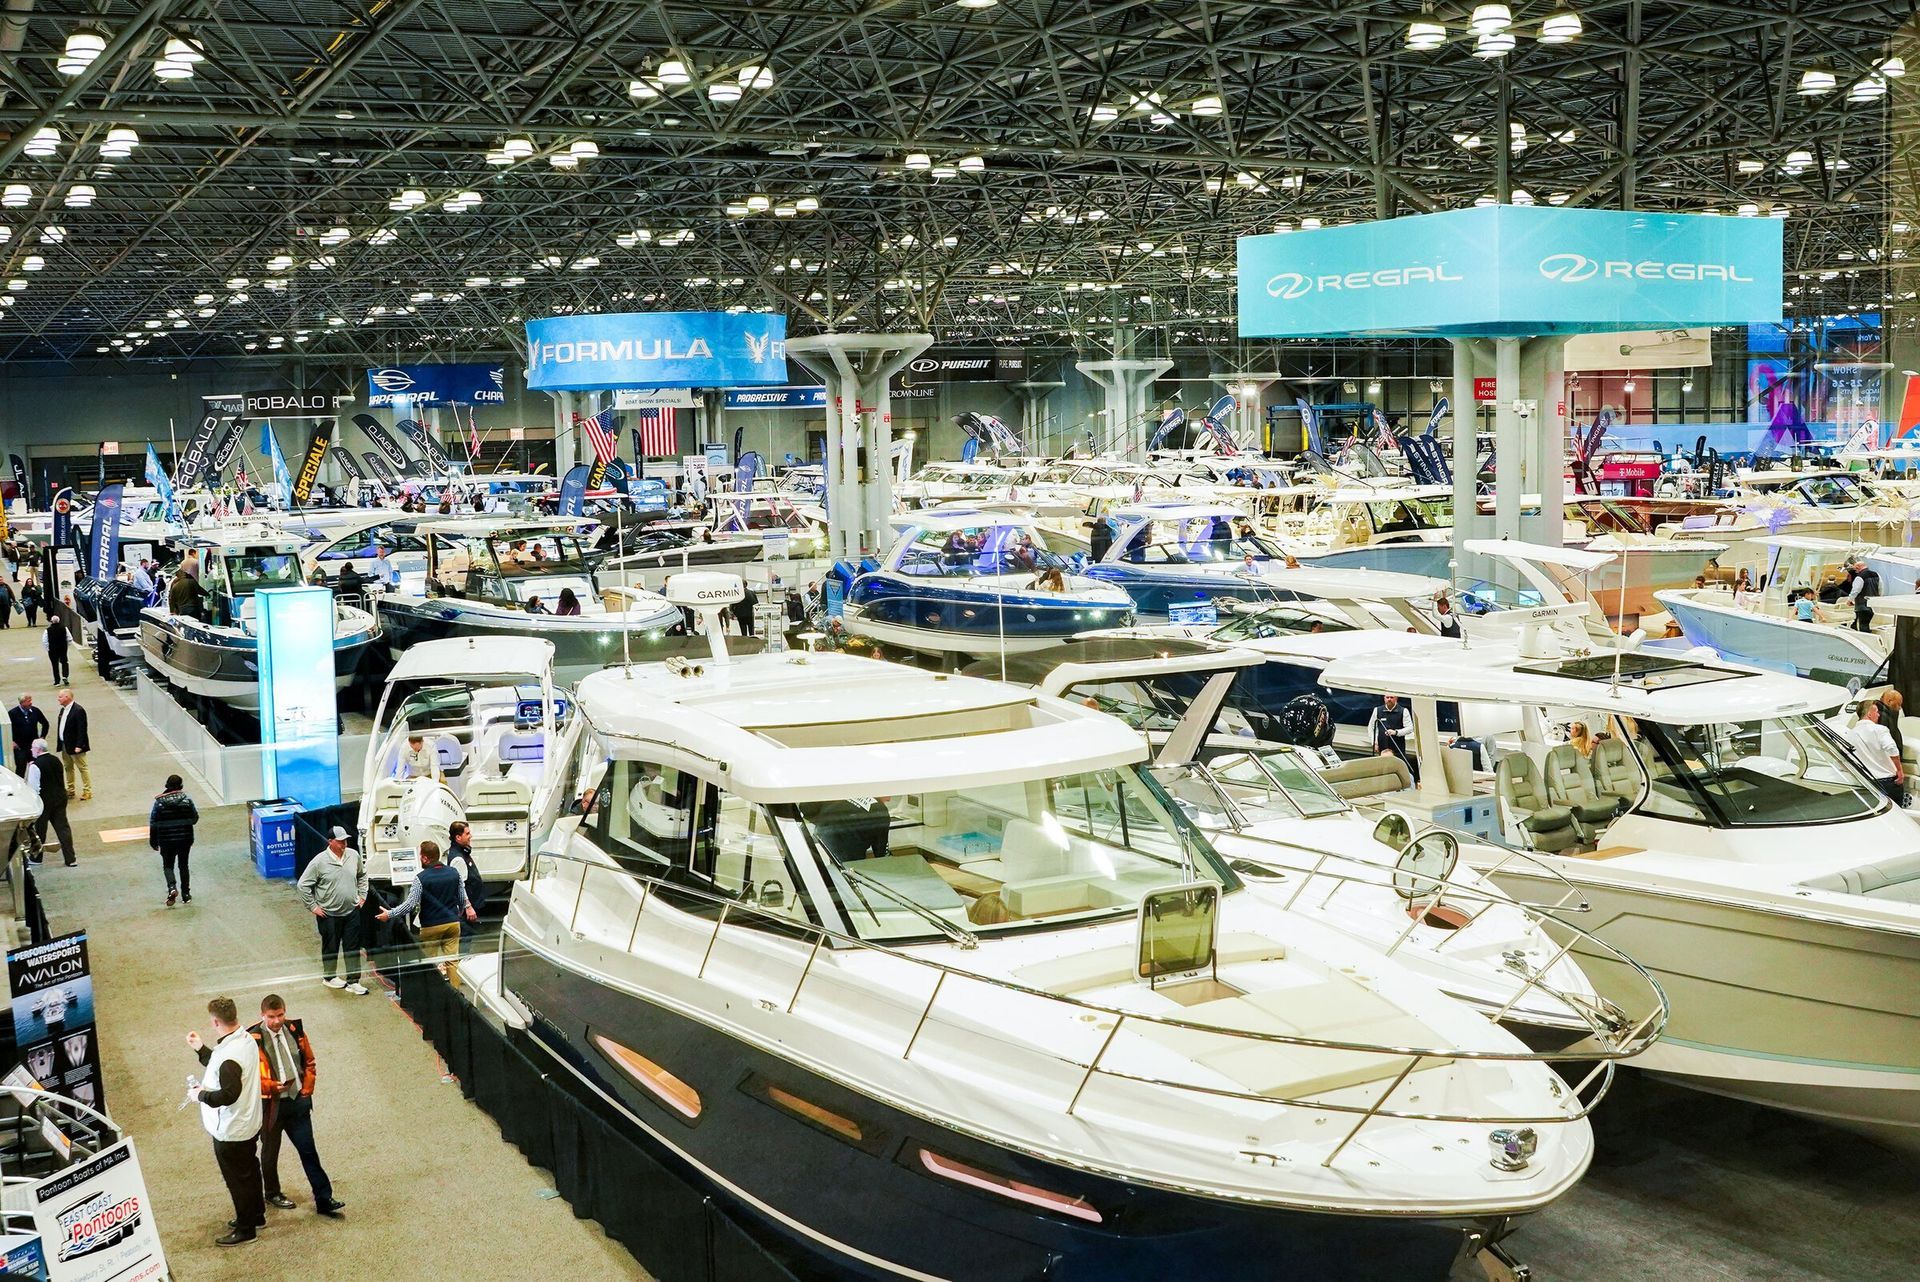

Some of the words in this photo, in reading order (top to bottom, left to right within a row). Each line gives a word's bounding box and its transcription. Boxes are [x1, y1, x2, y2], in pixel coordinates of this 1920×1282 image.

[1318, 264, 1463, 292] REGAL
[1605, 261, 1753, 282] REGAL
[542, 338, 713, 365] FORMULA
[941, 359, 990, 369] PURSUIT
[248, 395, 325, 411] ROBALO
[736, 393, 788, 403] PROGRESSIVE
[180, 416, 218, 488] ROBALO
[296, 435, 328, 501] SPECIALE
[697, 588, 740, 599] GARMIN
[1532, 608, 1558, 618] GARMIN
[266, 842, 289, 850] BOTTLES
[15, 938, 71, 962] PERFORMANCE
[26, 944, 81, 968] WATERSPORTS
[19, 957, 83, 987] AVALON
[39, 1174, 73, 1199] Pontoon
[72, 1166, 95, 1183] Boats
[94, 1163, 103, 1173] of
[102, 1156, 114, 1168] MA
[114, 1149, 128, 1162] Inc.
[63, 1209, 85, 1228] EAST
[86, 1193, 113, 1216] COAST
[73, 1196, 140, 1244] Pontoons
